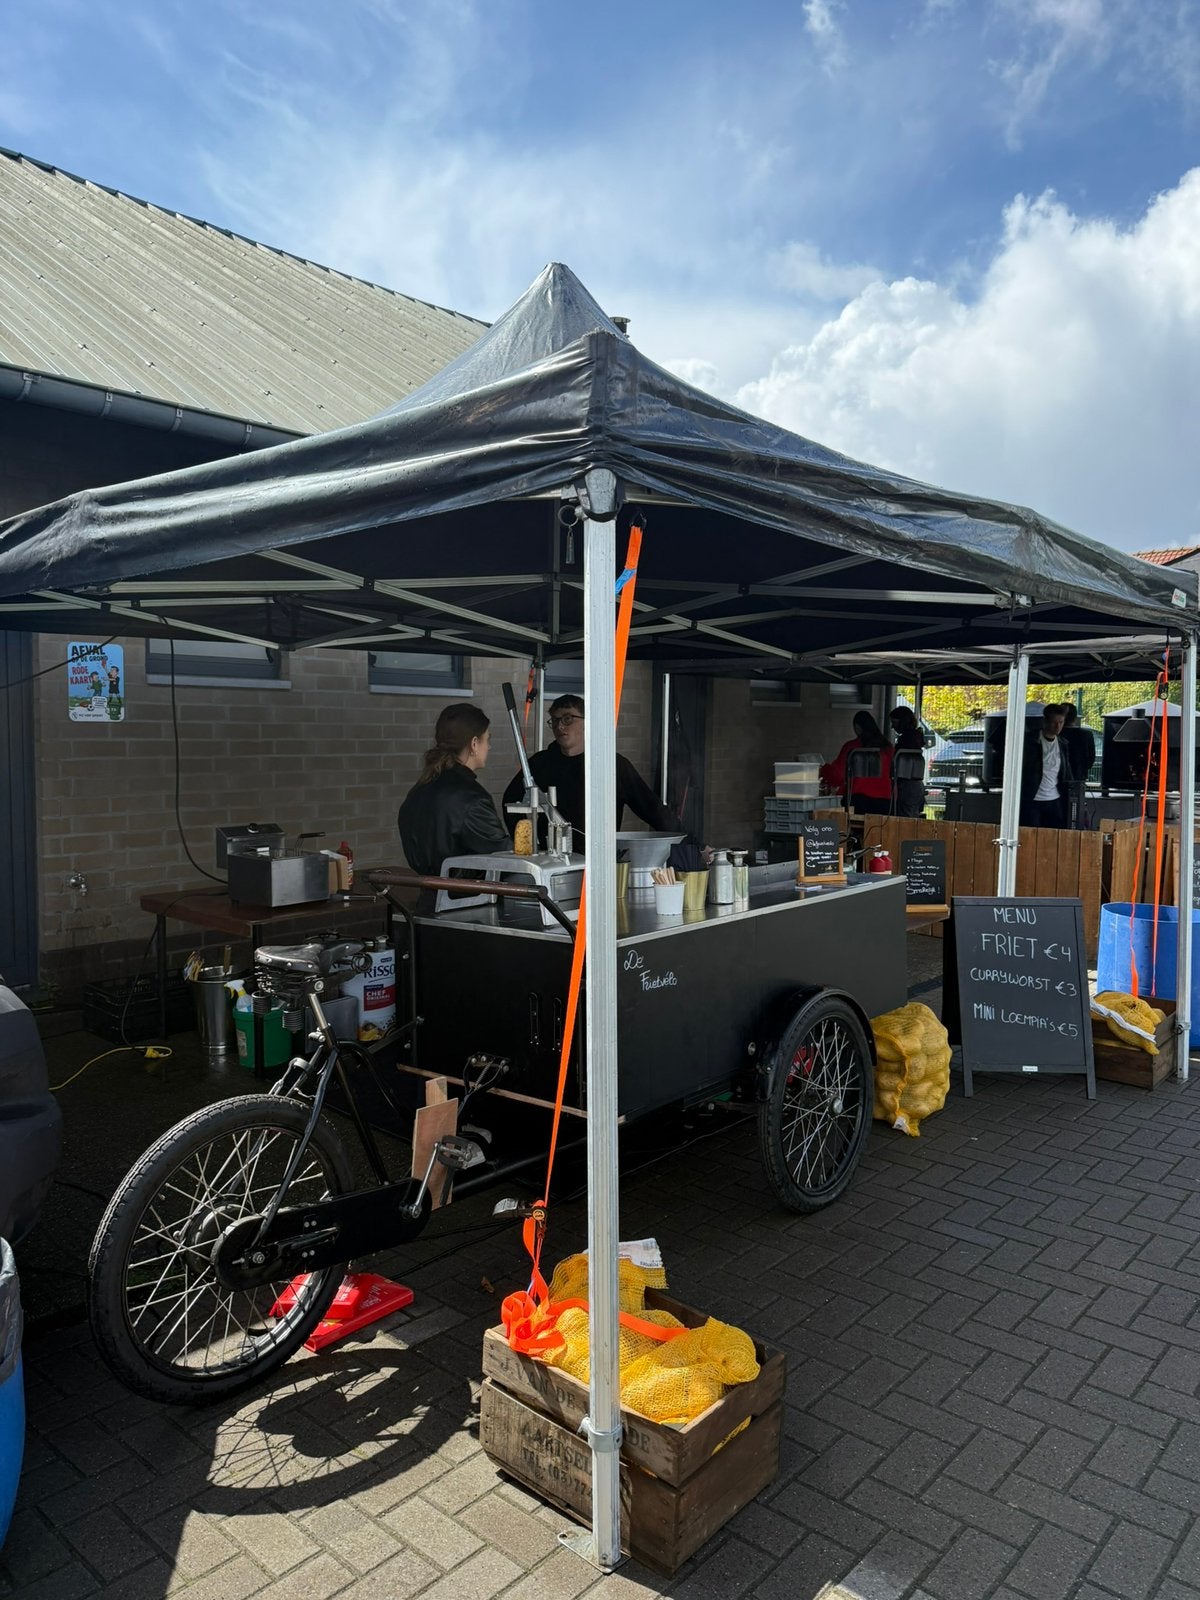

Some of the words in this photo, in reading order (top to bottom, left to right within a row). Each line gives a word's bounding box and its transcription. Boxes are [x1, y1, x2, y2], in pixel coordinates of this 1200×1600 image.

[72, 666, 89, 675] RODE
[993, 907, 1037, 925] MENU
[981, 931, 1038, 959] FRIET
[623, 949, 644, 971] De
[366, 989, 387, 997] CHEF
[973, 1002, 995, 1020] MINI
[521, 1421, 592, 1476] AARTSEL
